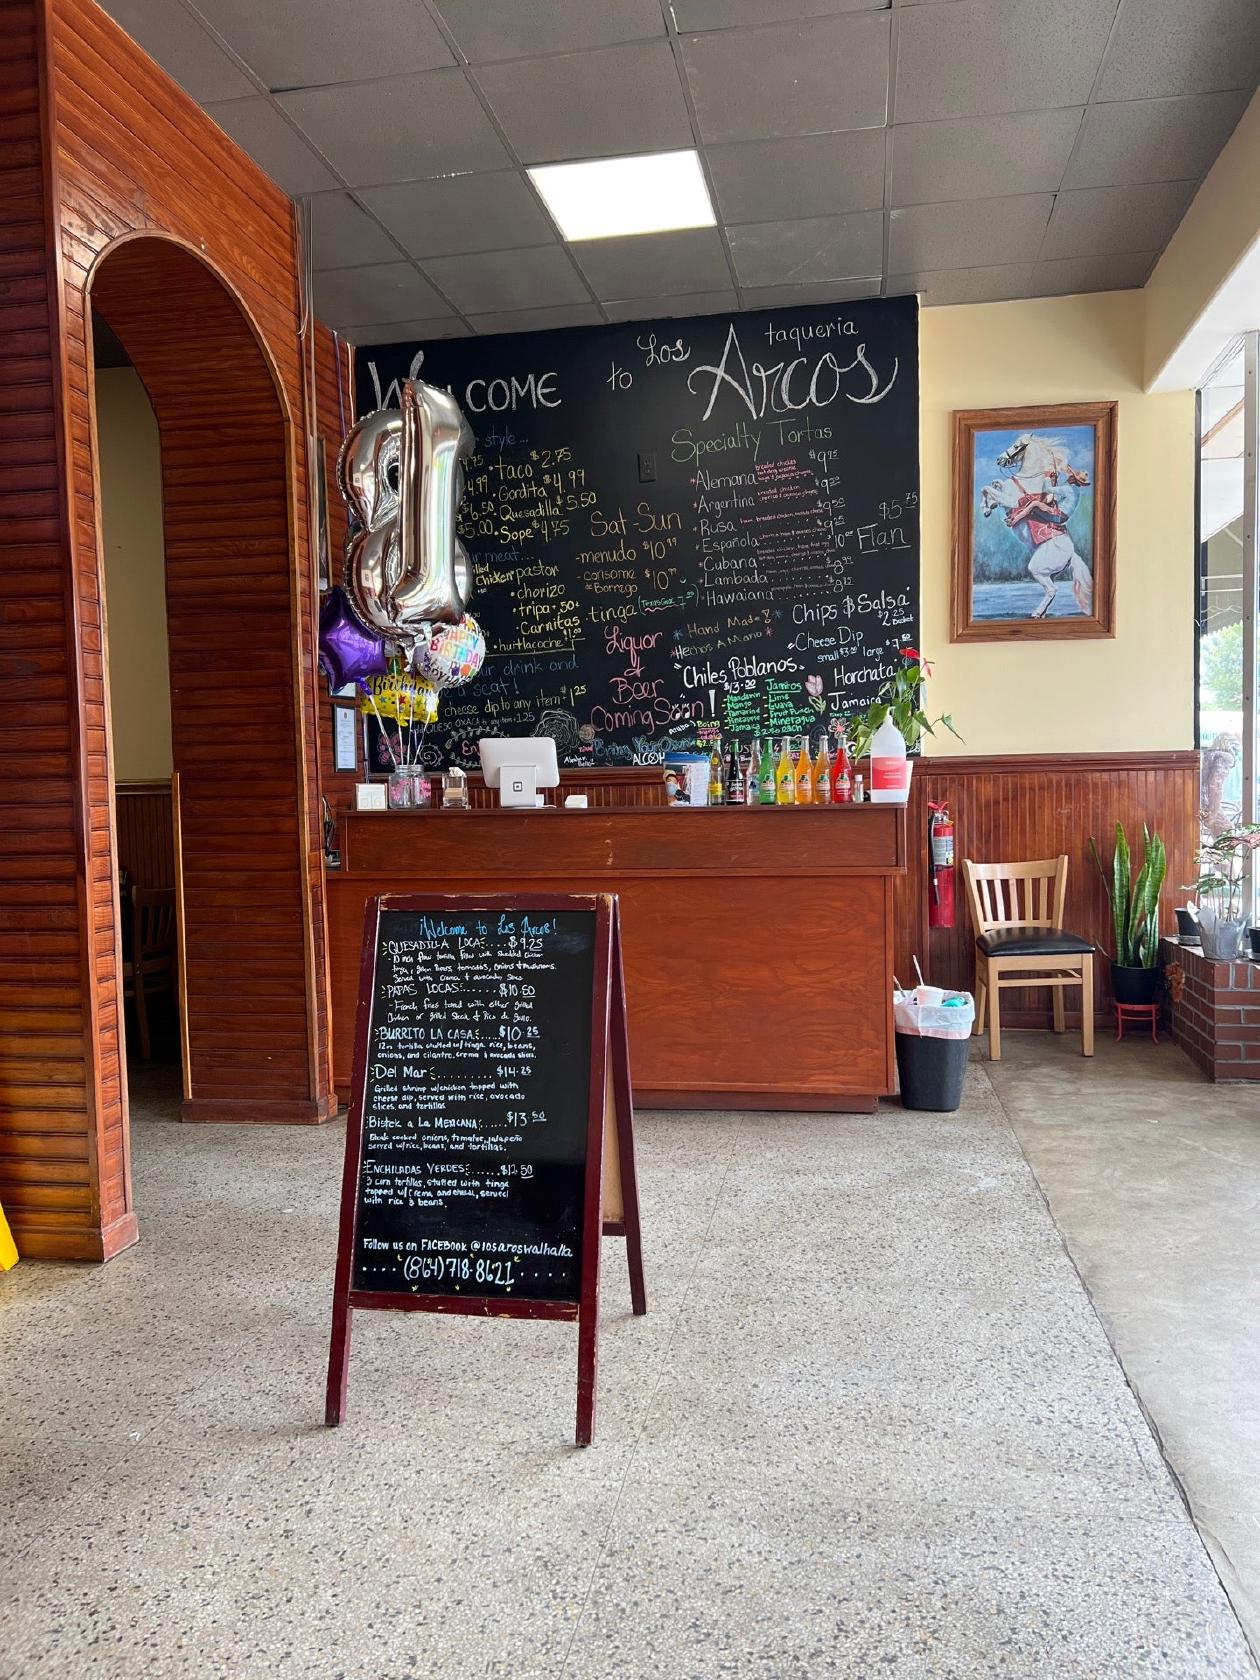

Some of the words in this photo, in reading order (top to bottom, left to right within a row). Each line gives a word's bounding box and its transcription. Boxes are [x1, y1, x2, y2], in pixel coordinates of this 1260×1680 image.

[764, 318, 858, 350] taqueria
[367, 350, 562, 412] WCOME
[606, 361, 632, 390] to
[637, 334, 691, 367] Los
[688, 322, 898, 420] Arcos
[672, 422, 761, 466] Specialty
[766, 416, 832, 445] Tortas
[495, 456, 533, 480] taco
[530, 448, 571, 468] $2.75
[499, 481, 547, 500] Gordita
[543, 469, 584, 494] $4.99
[696, 469, 758, 490] Alemana
[500, 499, 563, 521] Quesadilla
[556, 492, 596, 510] $5.50
[698, 490, 755, 518] Argentina
[500, 526, 534, 546] Sope
[532, 520, 570, 542] $4.75
[700, 519, 736, 536] Rusa
[857, 523, 907, 549] Flan
[702, 532, 760, 553] Española
[515, 560, 559, 585] pastor
[703, 556, 758, 572] Cubana
[704, 570, 768, 587] Lambada
[517, 583, 565, 600] chorizo
[593, 582, 637, 598] Borrego
[706, 588, 774, 607] Hawaiana
[519, 601, 550, 620] tripa
[588, 605, 637, 623] tinga
[792, 603, 838, 626] Chips
[858, 590, 910, 613] Salsa
[520, 612, 580, 635] Carnitas
[687, 621, 719, 638] Hand
[499, 637, 563, 652] huitlacoche
[604, 625, 662, 667] Liquor
[675, 642, 713, 659] Hechos
[727, 632, 762, 645] Mano
[795, 632, 837, 651] Cheese
[839, 626, 863, 645] Dip
[817, 651, 839, 663] small
[863, 646, 884, 661] large
[683, 661, 727, 688] Chiles
[728, 656, 797, 680] Poblanos
[834, 662, 896, 688] Horchata
[608, 677, 664, 704] Beer
[769, 694, 789, 702] Lime
[444, 700, 479, 717] cheese
[485, 699, 500, 717] dip
[500, 697, 510, 711] to
[513, 697, 531, 712] any
[536, 689, 560, 706] item
[769, 701, 793, 710] Guava
[591, 705, 655, 735] Coming
[770, 710, 788, 719] Fruit
[770, 716, 815, 726] Mineragua
[782, 724, 802, 733] each
[476, 919, 487, 935] to
[498, 914, 516, 935] Los
[521, 915, 557, 937] Arcos!
[388, 938, 450, 954] QUESADILLA
[458, 937, 481, 948] LOCA
[508, 936, 543, 951] $9.25
[387, 983, 417, 998] PAPAS
[427, 983, 460, 994] LOCAS
[499, 982, 535, 998] $10.50
[379, 1026, 425, 1040] BURRITO
[431, 1028, 443, 1040] LA
[448, 1029, 473, 1040] CASA
[373, 1063, 397, 1079] Del
[403, 1066, 427, 1079] Mar
[374, 1084, 397, 1093] Grilled
[469, 1082, 495, 1092] topped
[500, 1082, 519, 1090] with
[398, 1102, 412, 1110] and
[418, 1093, 445, 1102] served
[448, 1093, 466, 1102] with
[368, 1116, 402, 1131] Bistek
[418, 1117, 430, 1127] La
[450, 1142, 464, 1150] and
[365, 1160, 421, 1174] ENCHILADAS
[427, 1162, 465, 1174] VERDES
[366, 1176, 372, 1186] 3
[460, 1179, 480, 1187] with
[485, 1180, 509, 1190] tinga
[364, 1197, 382, 1205] with
[363, 1238, 389, 1250] Follow
[393, 1241, 403, 1251] us
[406, 1241, 417, 1251] on
